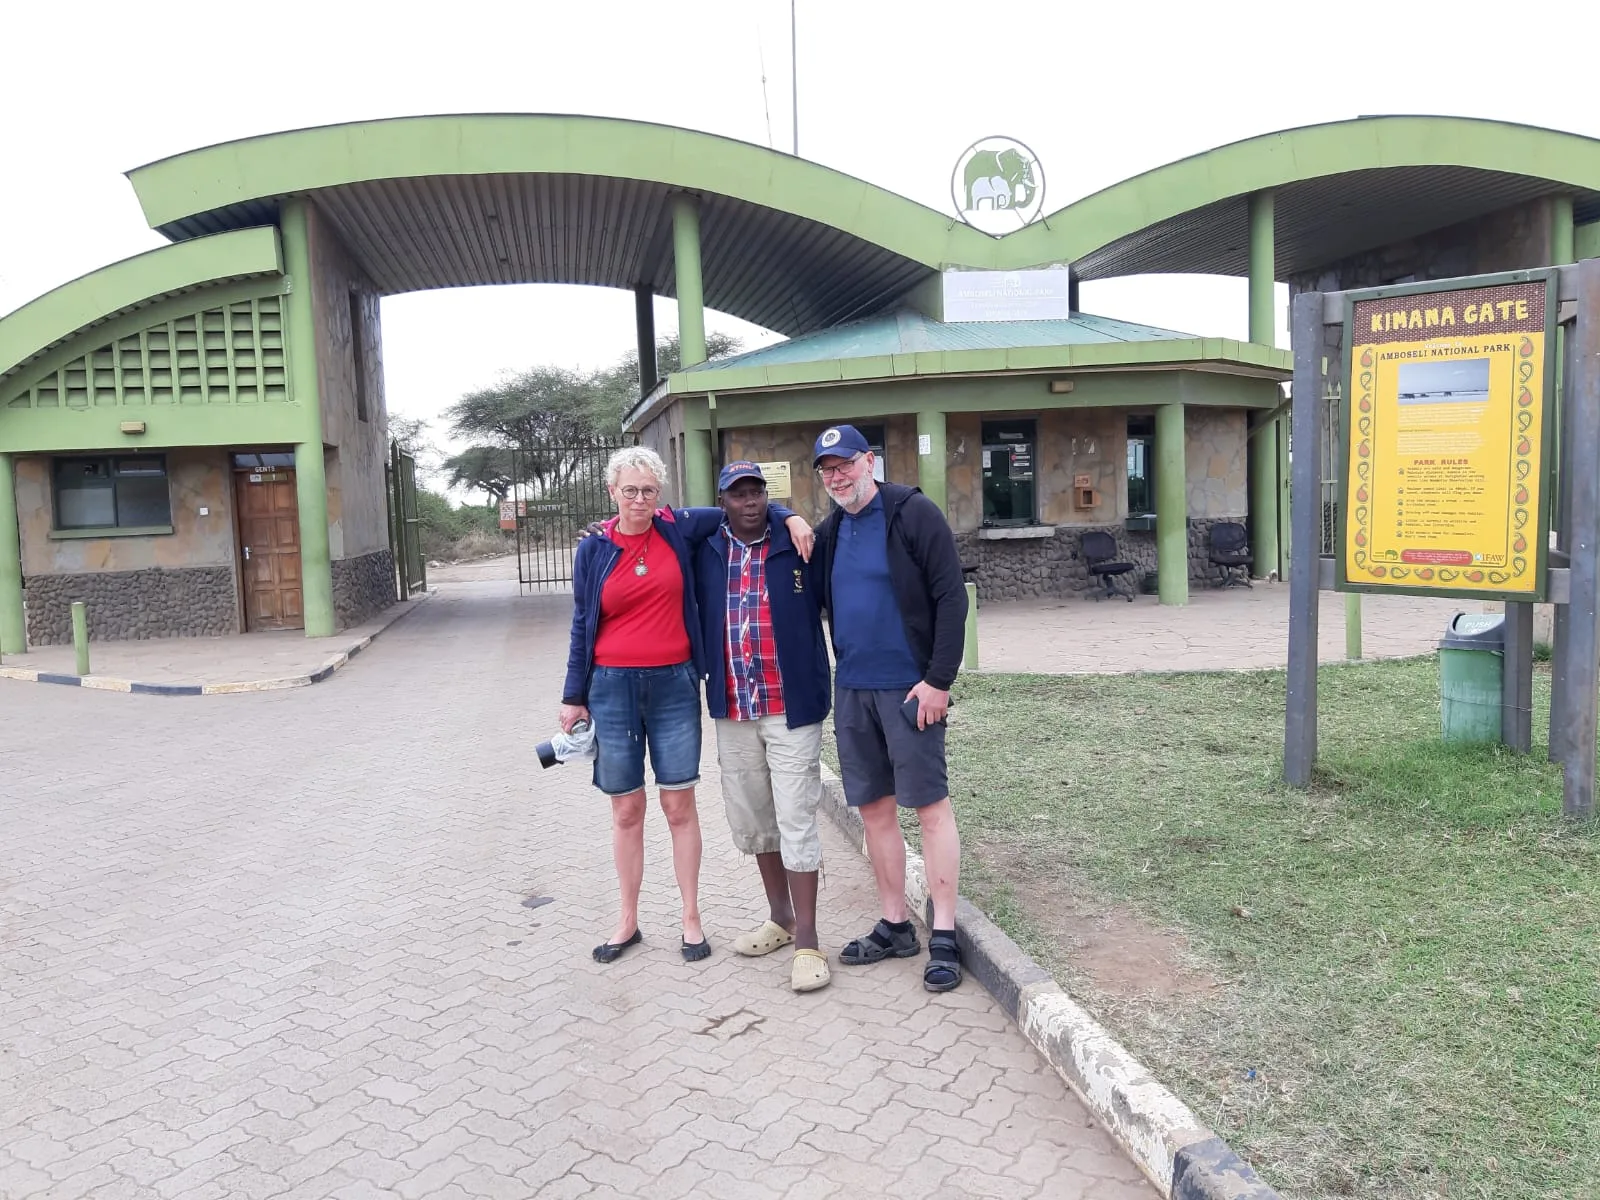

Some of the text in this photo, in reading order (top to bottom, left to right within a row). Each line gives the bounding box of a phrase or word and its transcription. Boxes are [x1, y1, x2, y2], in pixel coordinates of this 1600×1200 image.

[1371, 300, 1529, 332] KIMANA GATE
[1380, 343, 1510, 361] AMBOSELI NATIONAL PARK
[1441, 458, 1468, 466] RULES
[537, 504, 561, 512] ENTRY
[1482, 553, 1505, 562] IFAW
